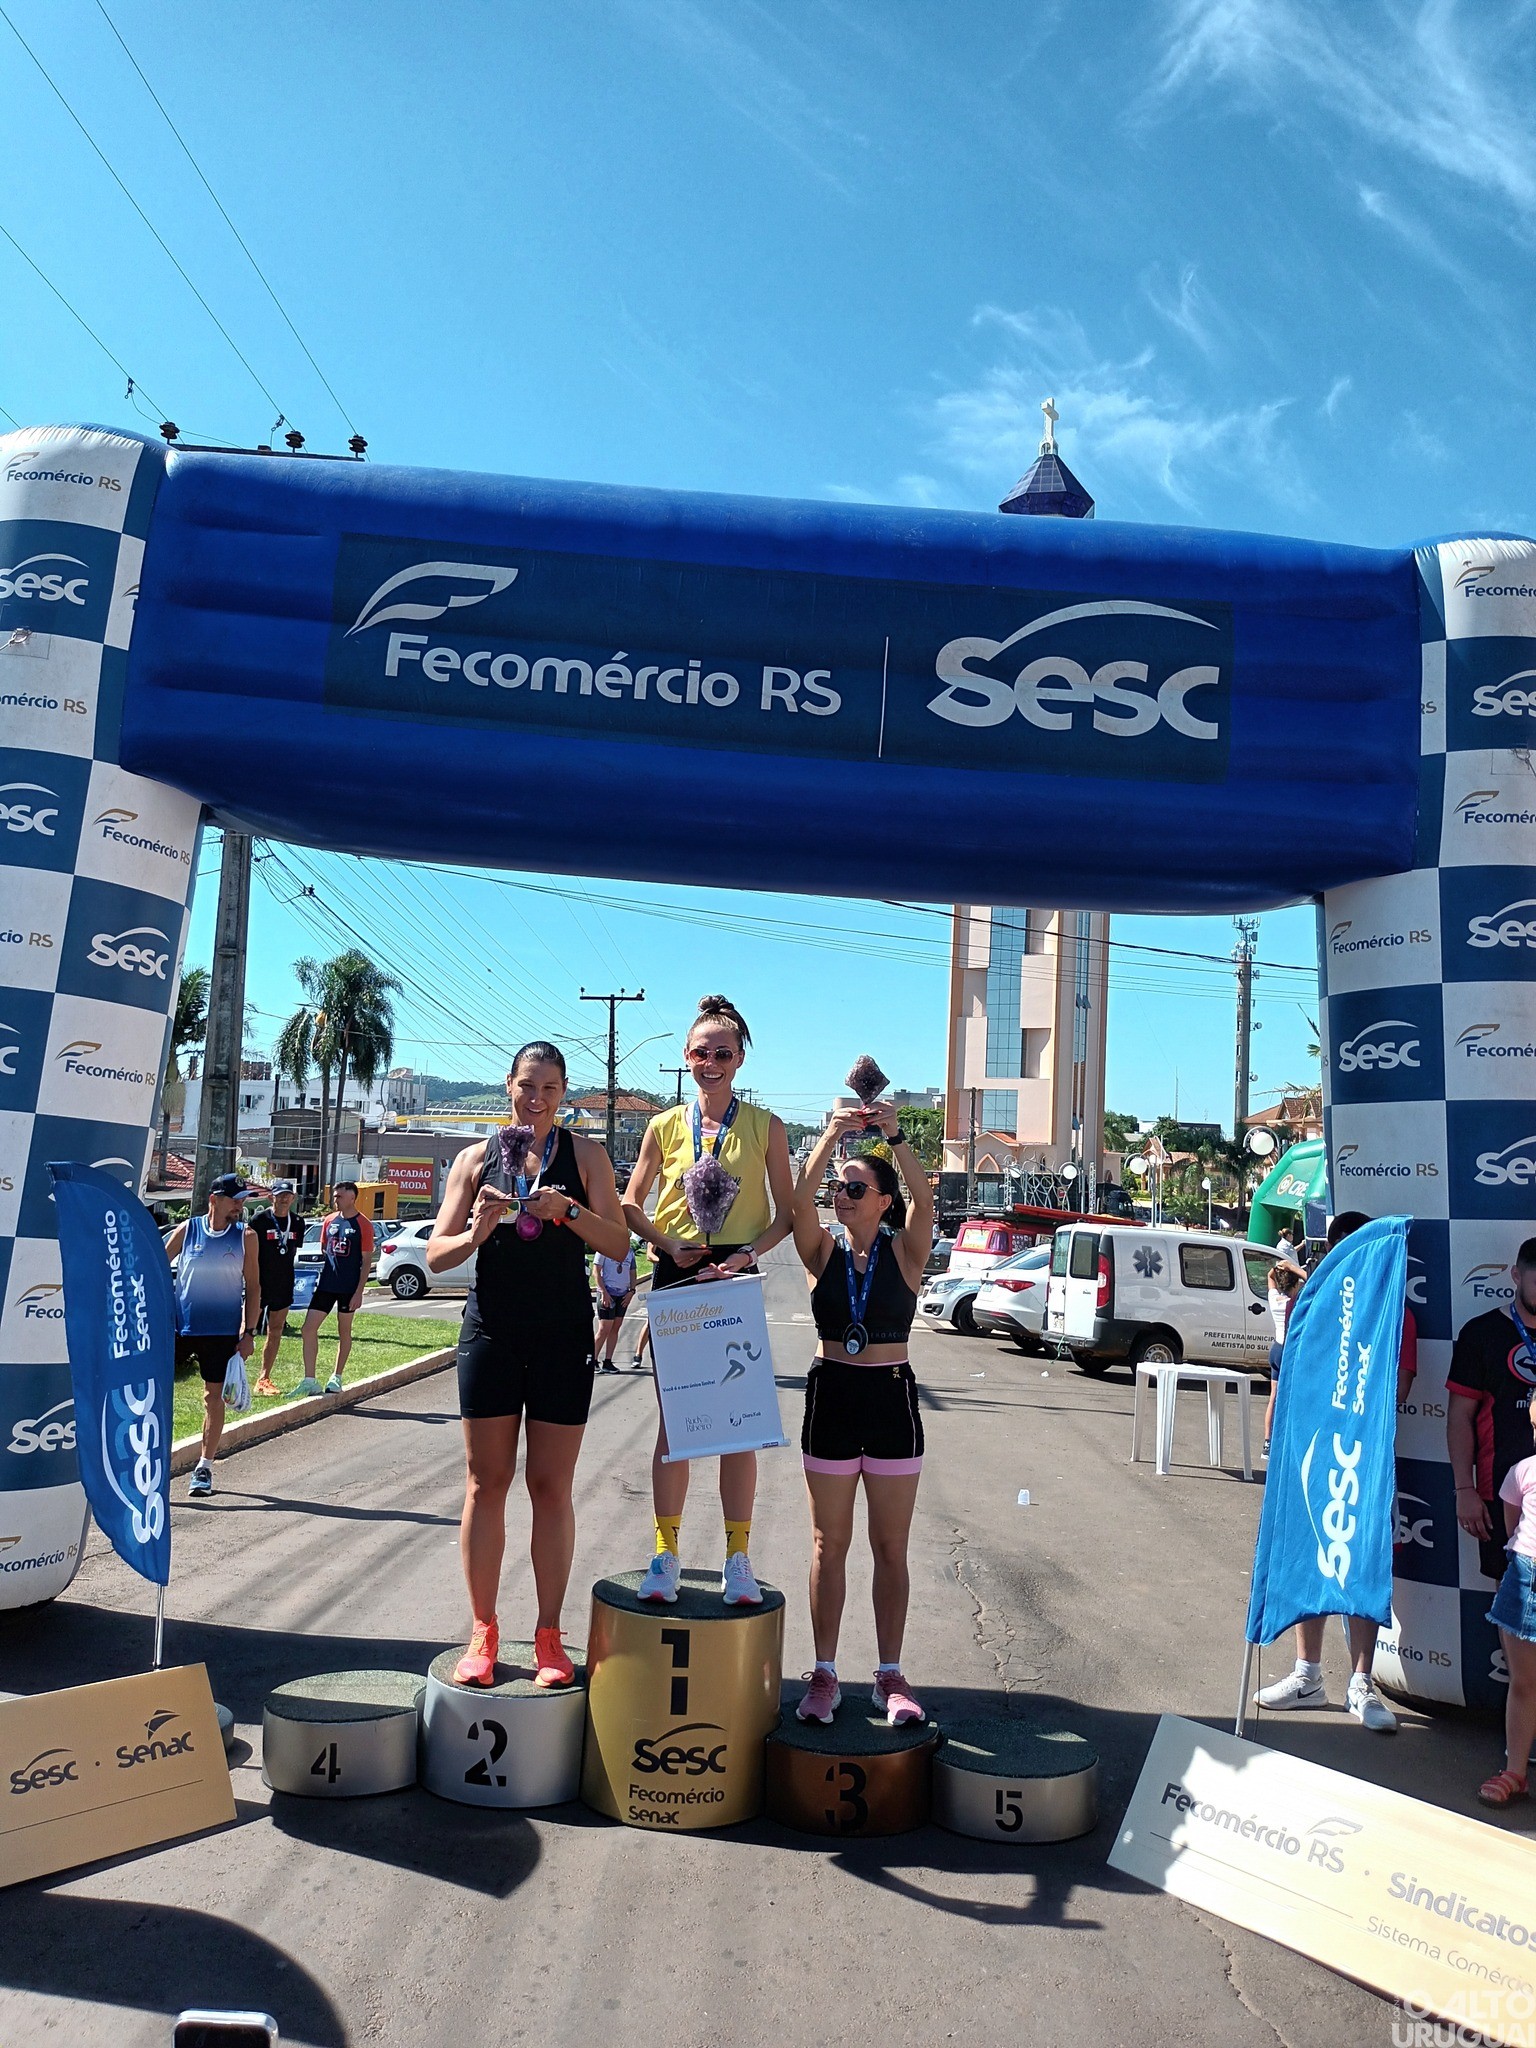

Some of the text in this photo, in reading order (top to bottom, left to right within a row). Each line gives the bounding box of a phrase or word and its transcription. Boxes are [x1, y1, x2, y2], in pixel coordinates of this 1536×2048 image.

[6, 468, 122, 492] Fecomércio RS
[384, 632, 842, 717] Fecomércio RS
[927, 636, 1220, 740] Sesc
[0, 692, 88, 715] mércio RS
[1464, 809, 1536, 824] Fecomér
[102, 825, 191, 866] Fecomércio RS
[28, 931, 54, 948] RS
[86, 933, 170, 981] Sesc
[1333, 929, 1432, 955] Fecomércio RS
[64, 1058, 156, 1087] Fecomércio RS
[1338, 1039, 1421, 1073] Sesc
[399, 1181, 427, 1190] MODA
[1339, 1162, 1439, 1178] Fecomércio RS
[1474, 1152, 1536, 1186] Se
[104, 1209, 131, 1359] Fecomércio
[130, 1273, 151, 1352] Senac
[656, 1316, 743, 1337] GRUPO DE CORRIDA
[1203, 1331, 1276, 1342] PREFEITURA MUNICIP
[1211, 1341, 1245, 1350] AMETISTA
[1331, 1275, 1356, 1411] Fecomércio
[1352, 1341, 1373, 1417] Senac
[1423, 1402, 1446, 1418] RS
[123, 1377, 165, 1545] Sesc
[1317, 1431, 1362, 1591] Sesc
[66, 1543, 79, 1560] RS
[660, 1628, 690, 1715] 1
[1428, 1650, 1452, 1668] RS
[10, 1731, 195, 1795] Sesc Senac
[310, 1742, 341, 1783] 4
[464, 1718, 508, 1787] 2
[631, 1738, 728, 1775] Sesc
[628, 1783, 725, 1804] Fecomércio
[825, 1762, 868, 1833] 3
[995, 1789, 1023, 1833] 5
[628, 1805, 680, 1825] Senac
[1160, 1782, 1301, 1856] Fecomércio
[1307, 1838, 1345, 1874] RS
[1366, 1915, 1441, 1961] Sistema
